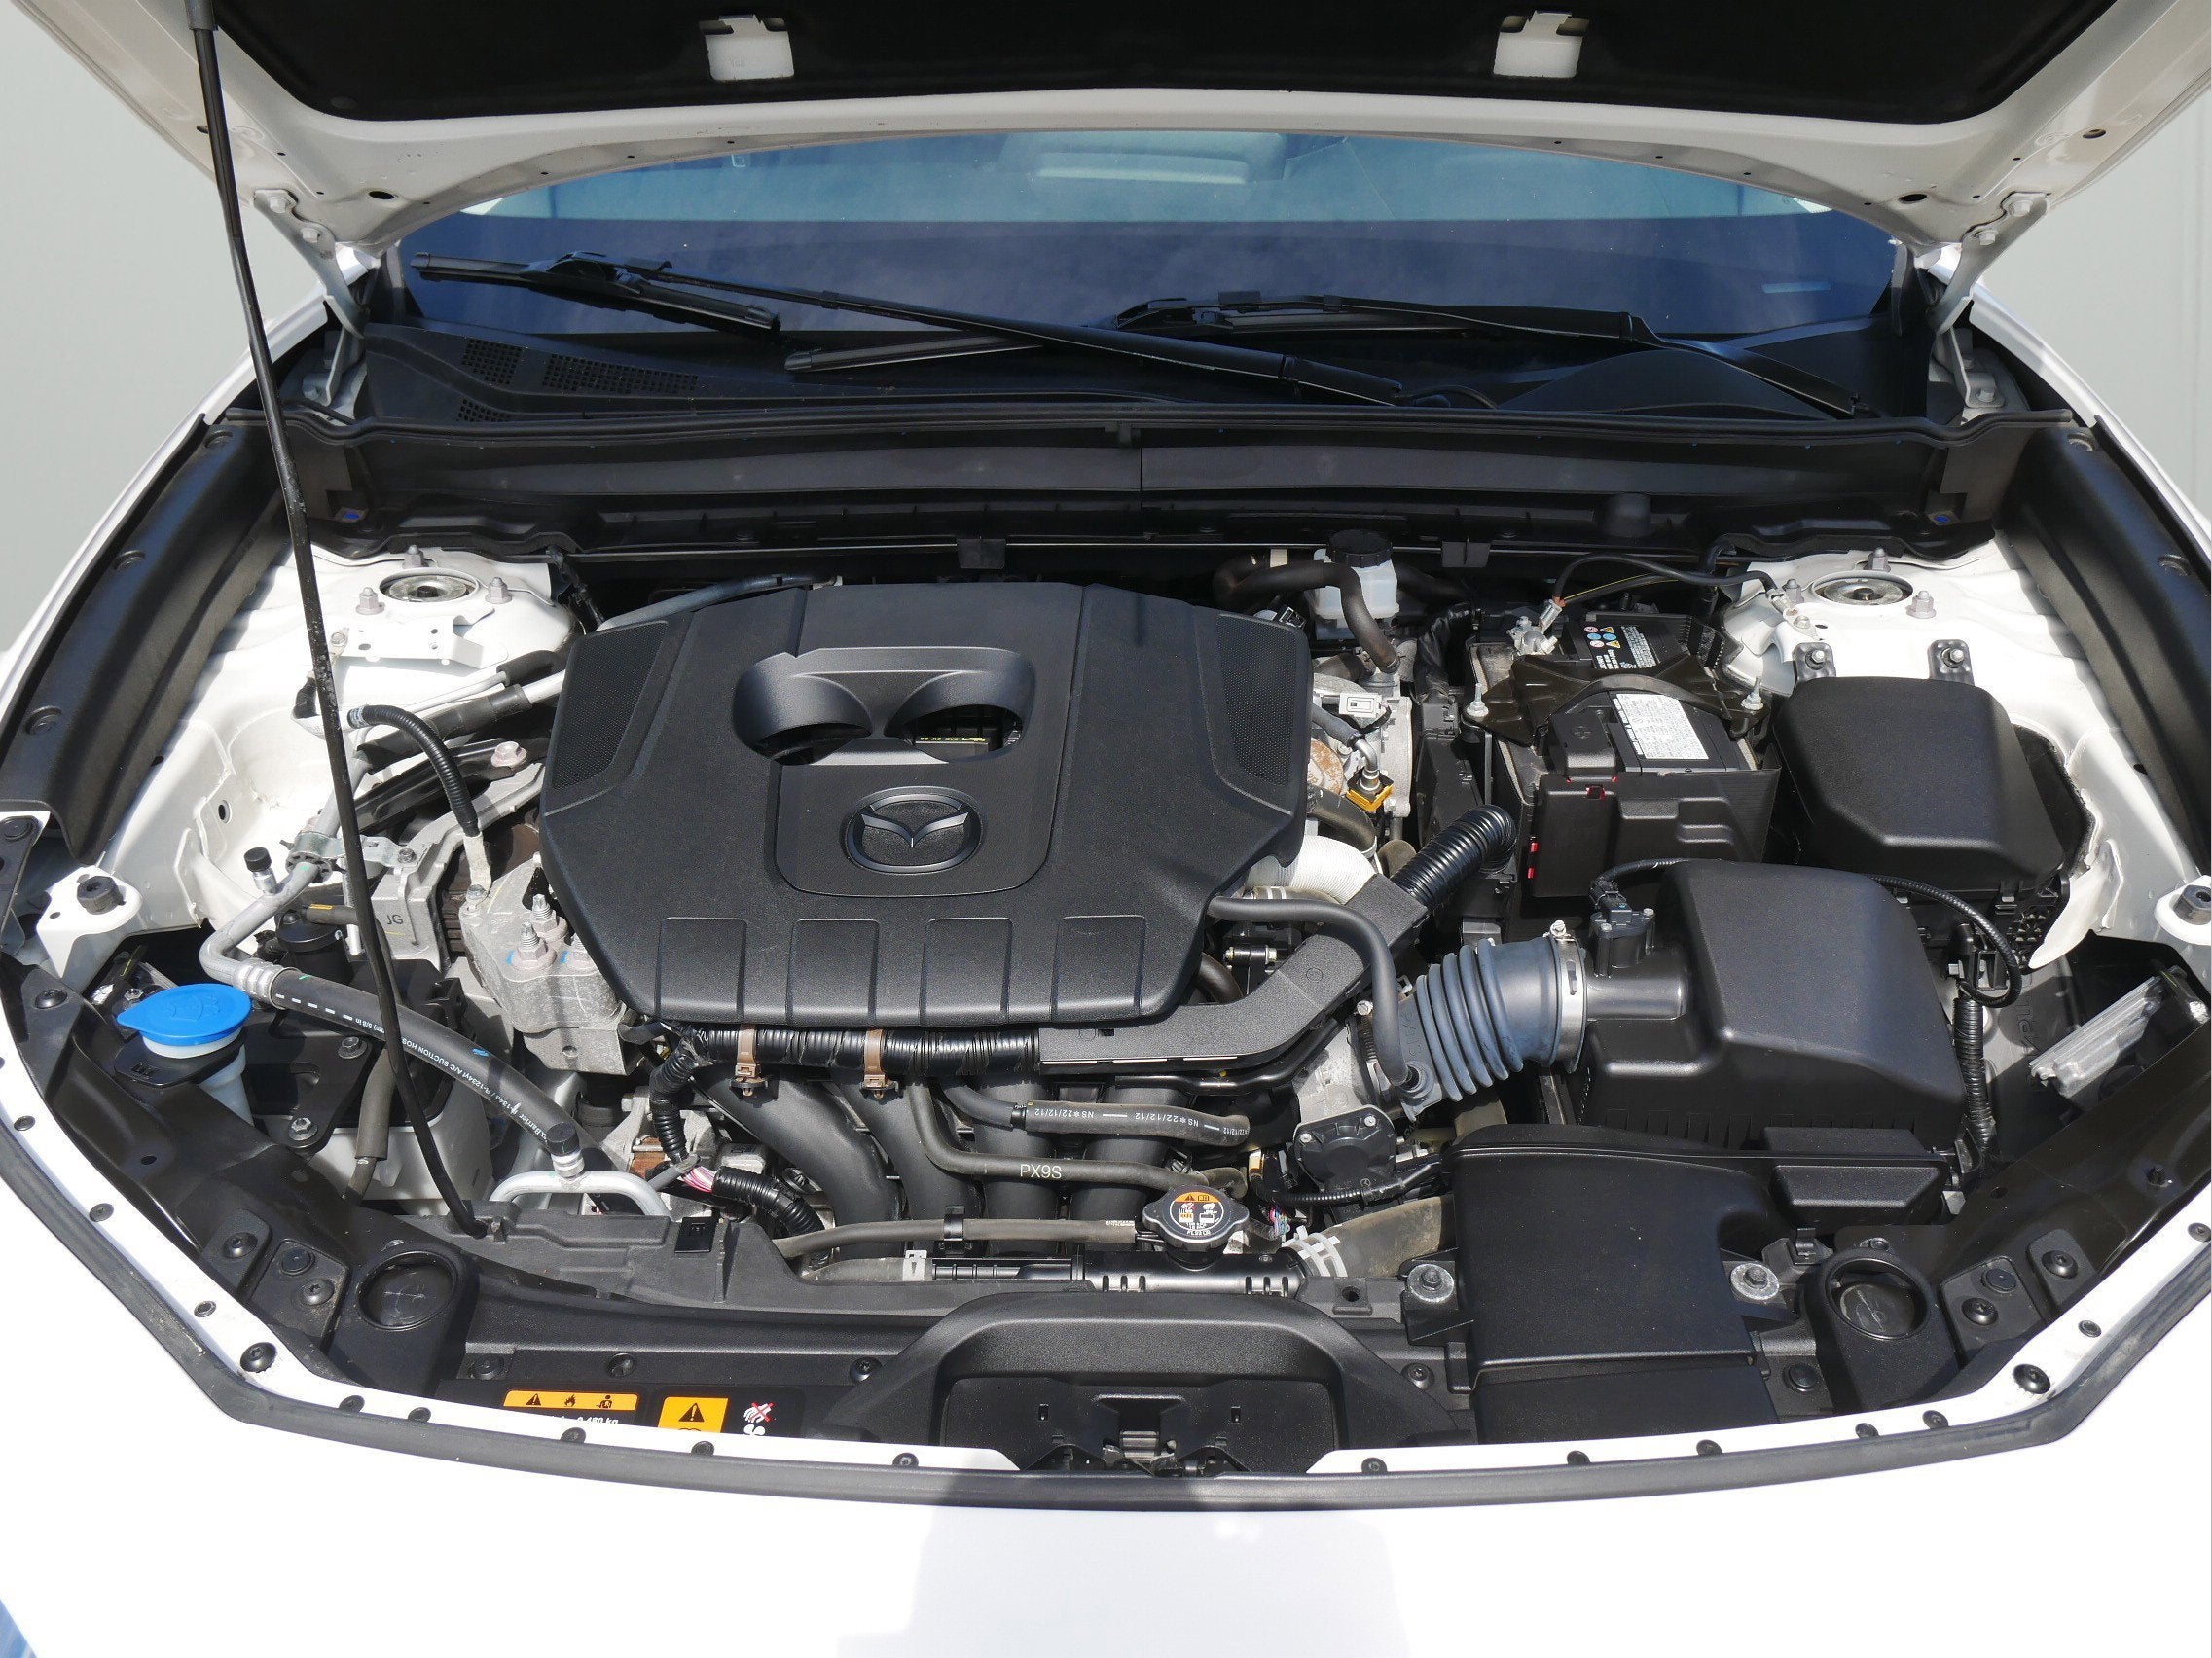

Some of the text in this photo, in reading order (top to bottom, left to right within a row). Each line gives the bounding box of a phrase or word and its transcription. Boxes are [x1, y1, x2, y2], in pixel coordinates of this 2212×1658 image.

[401, 1037, 417, 1050] HOS
[418, 1046, 449, 1067] SUCTION
[449, 1063, 463, 1075] A/C
[1020, 1163, 1062, 1179] PX9S
